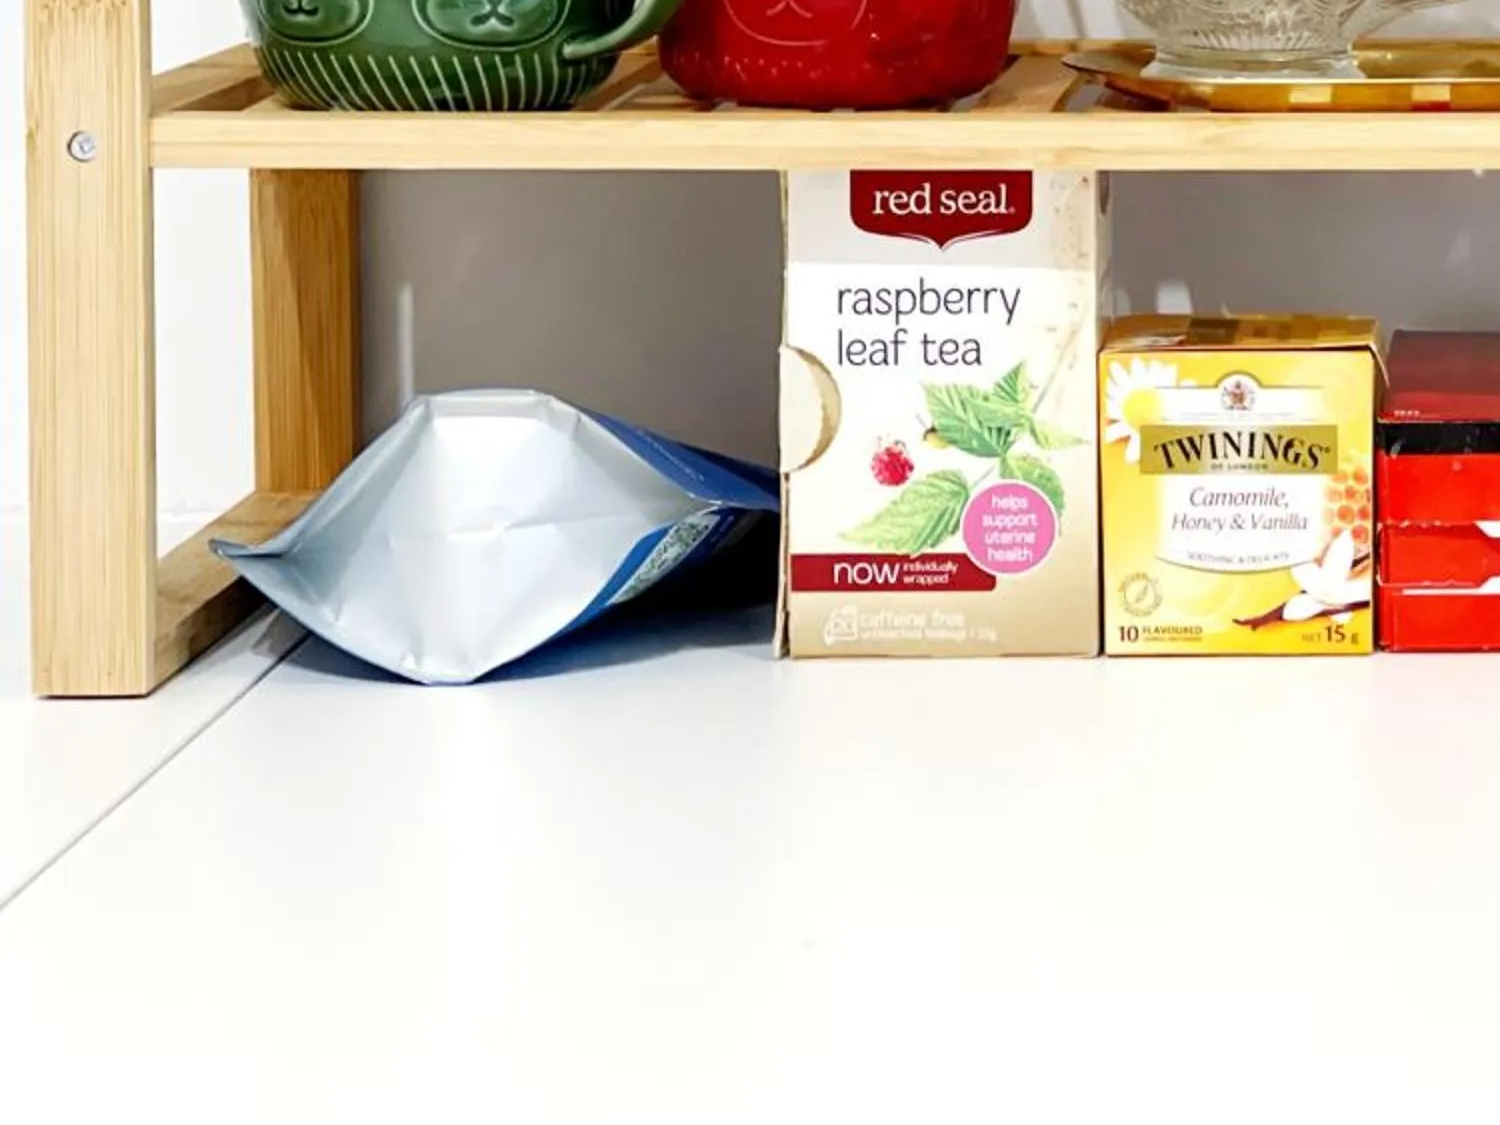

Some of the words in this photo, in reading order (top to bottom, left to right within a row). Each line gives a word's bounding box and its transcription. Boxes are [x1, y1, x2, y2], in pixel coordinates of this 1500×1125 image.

[871, 182, 931, 215] red
[836, 277, 1021, 326] raspberry
[836, 328, 908, 366] leaf
[921, 332, 982, 366] tea
[991, 493, 1029, 512] helps
[1189, 485, 1290, 509] Camomile,
[982, 513, 1038, 530] support
[1171, 511, 1226, 534] Honey
[1228, 512, 1246, 531] &
[1250, 511, 1309, 531] Vanilla
[984, 530, 1036, 545] uterine
[986, 546, 1033, 563] health
[833, 561, 900, 585] now
[903, 574, 950, 586] wrapped
[1119, 625, 1140, 643] 10
